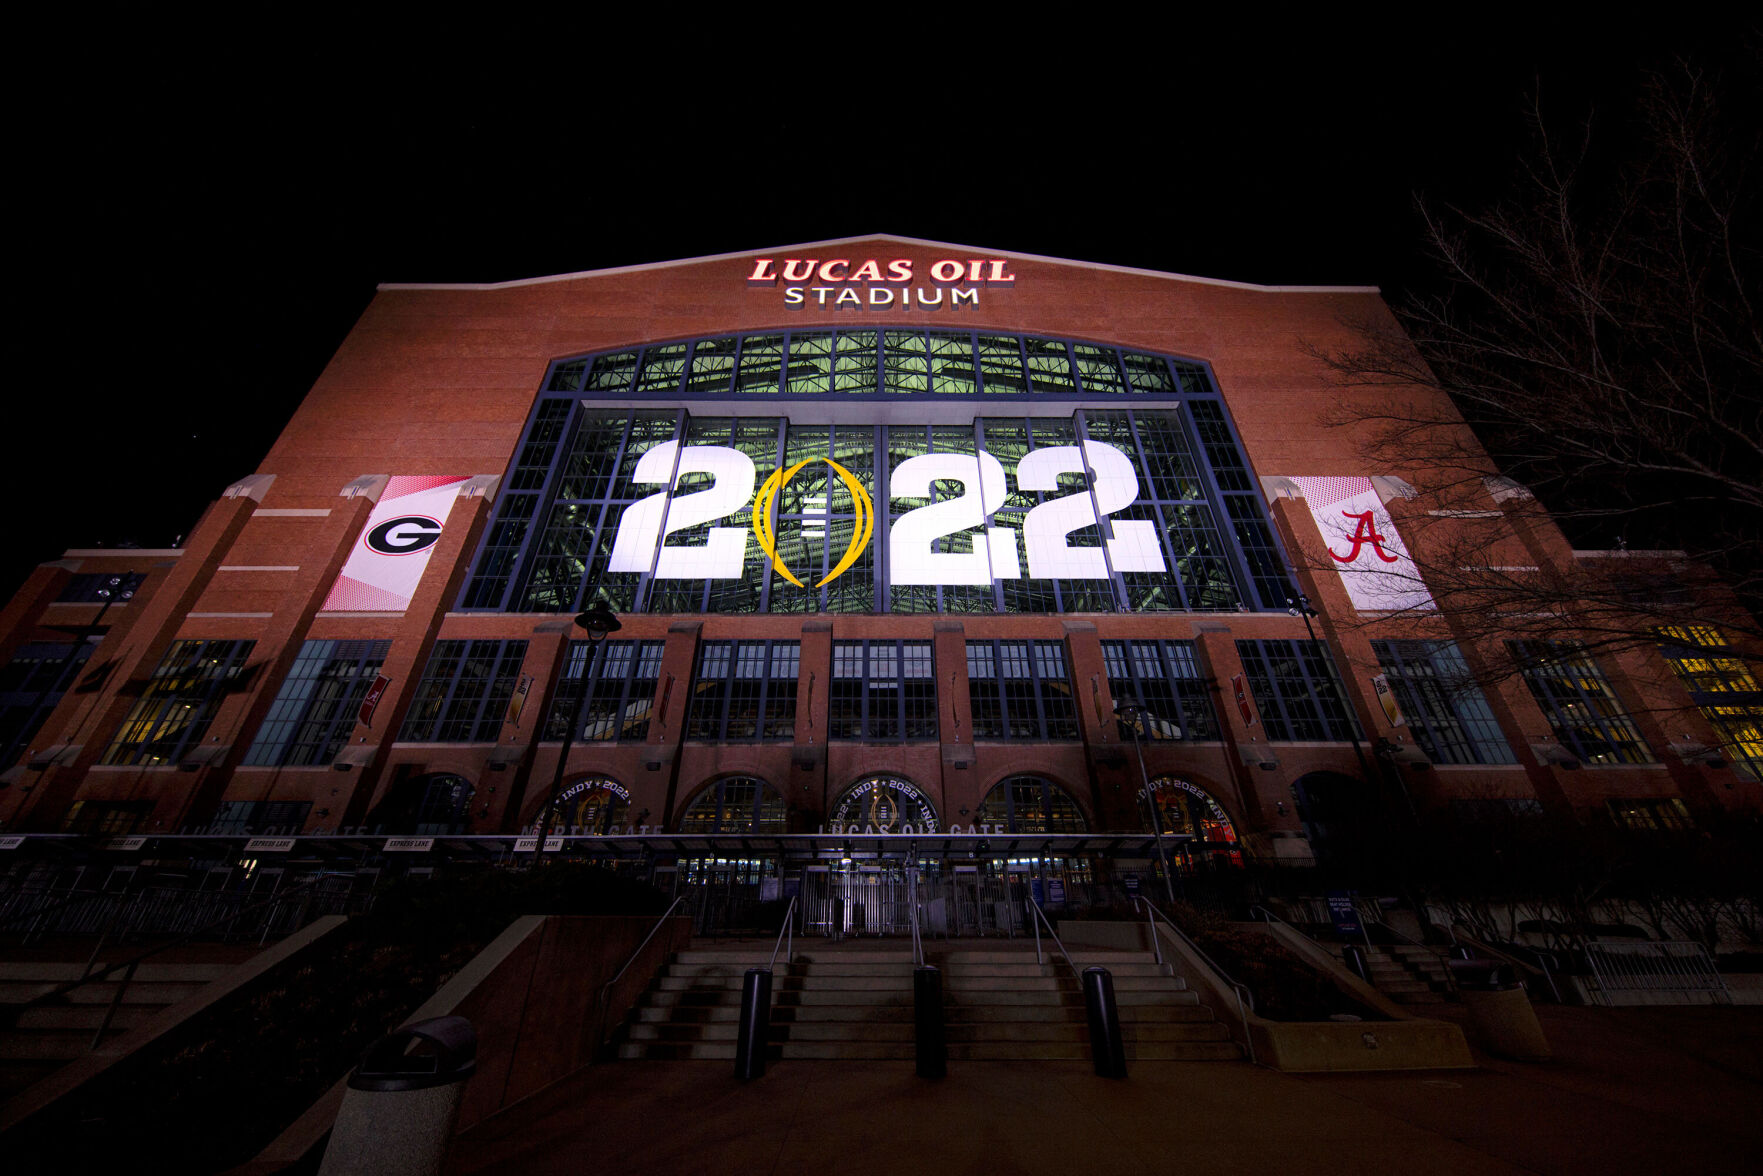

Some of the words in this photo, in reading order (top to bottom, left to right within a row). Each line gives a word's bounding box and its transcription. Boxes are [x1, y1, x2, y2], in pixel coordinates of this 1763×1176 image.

[747, 259, 914, 283] LUCAS
[929, 259, 1016, 283] OIL
[783, 287, 980, 306] STADIUM
[561, 780, 594, 801] INDY
[602, 779, 630, 800] 2022
[850, 779, 879, 800] INDY
[888, 779, 918, 800] 2022
[1173, 779, 1207, 800] 2022
[818, 823, 890, 835] LUCAS
[950, 823, 1004, 835] GATE
